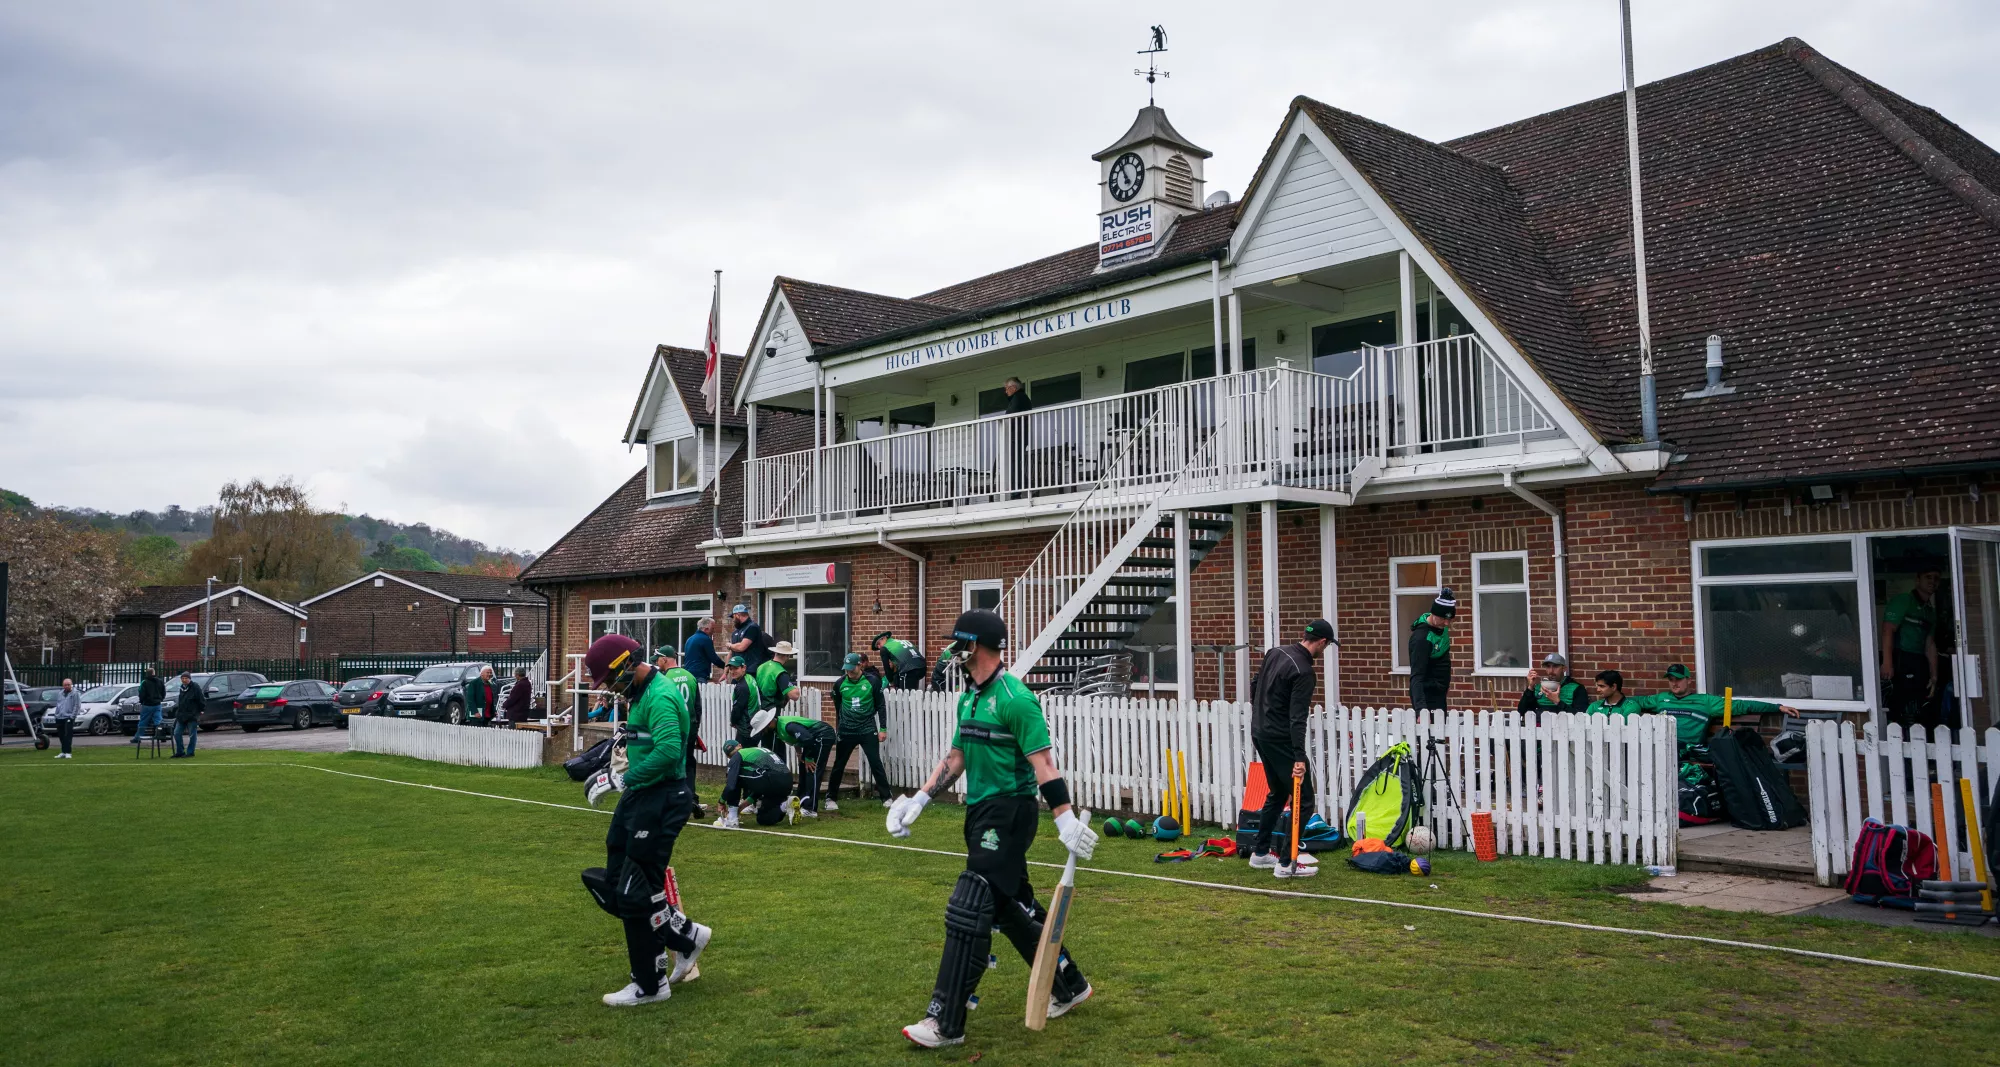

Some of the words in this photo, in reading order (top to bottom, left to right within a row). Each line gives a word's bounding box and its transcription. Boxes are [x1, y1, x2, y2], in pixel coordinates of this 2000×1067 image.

[1102, 204, 1152, 232] RUSH
[1102, 221, 1152, 242] ELECTRICS
[886, 349, 920, 370] HIGH
[925, 330, 999, 361] WYCOMBE
[1004, 310, 1077, 342] CRICKET
[1084, 298, 1131, 323] CLUB
